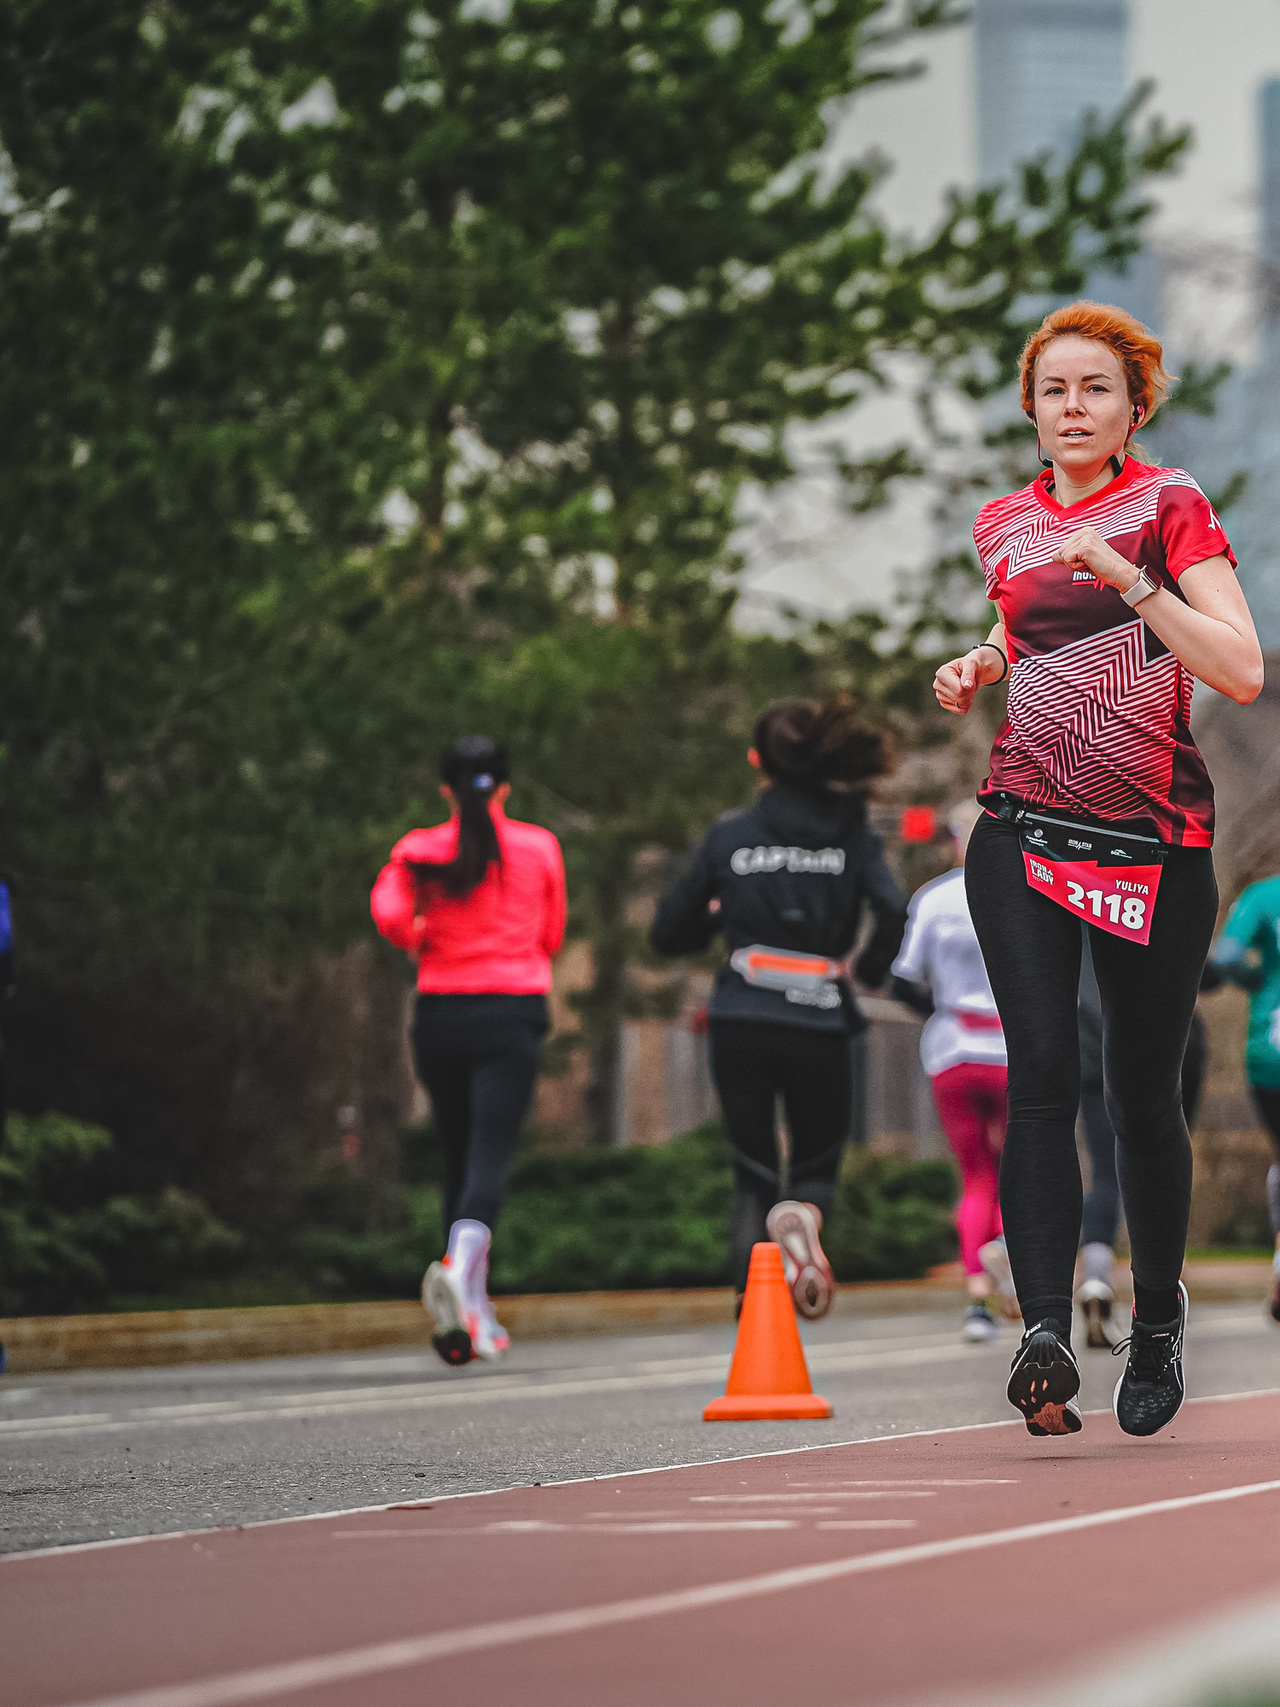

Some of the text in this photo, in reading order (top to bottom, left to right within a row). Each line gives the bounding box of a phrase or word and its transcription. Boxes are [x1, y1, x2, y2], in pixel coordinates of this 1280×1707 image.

[1031, 865, 1055, 886] LADY
[1115, 879, 1149, 895] YULIYA
[1066, 880, 1147, 930] 2118
